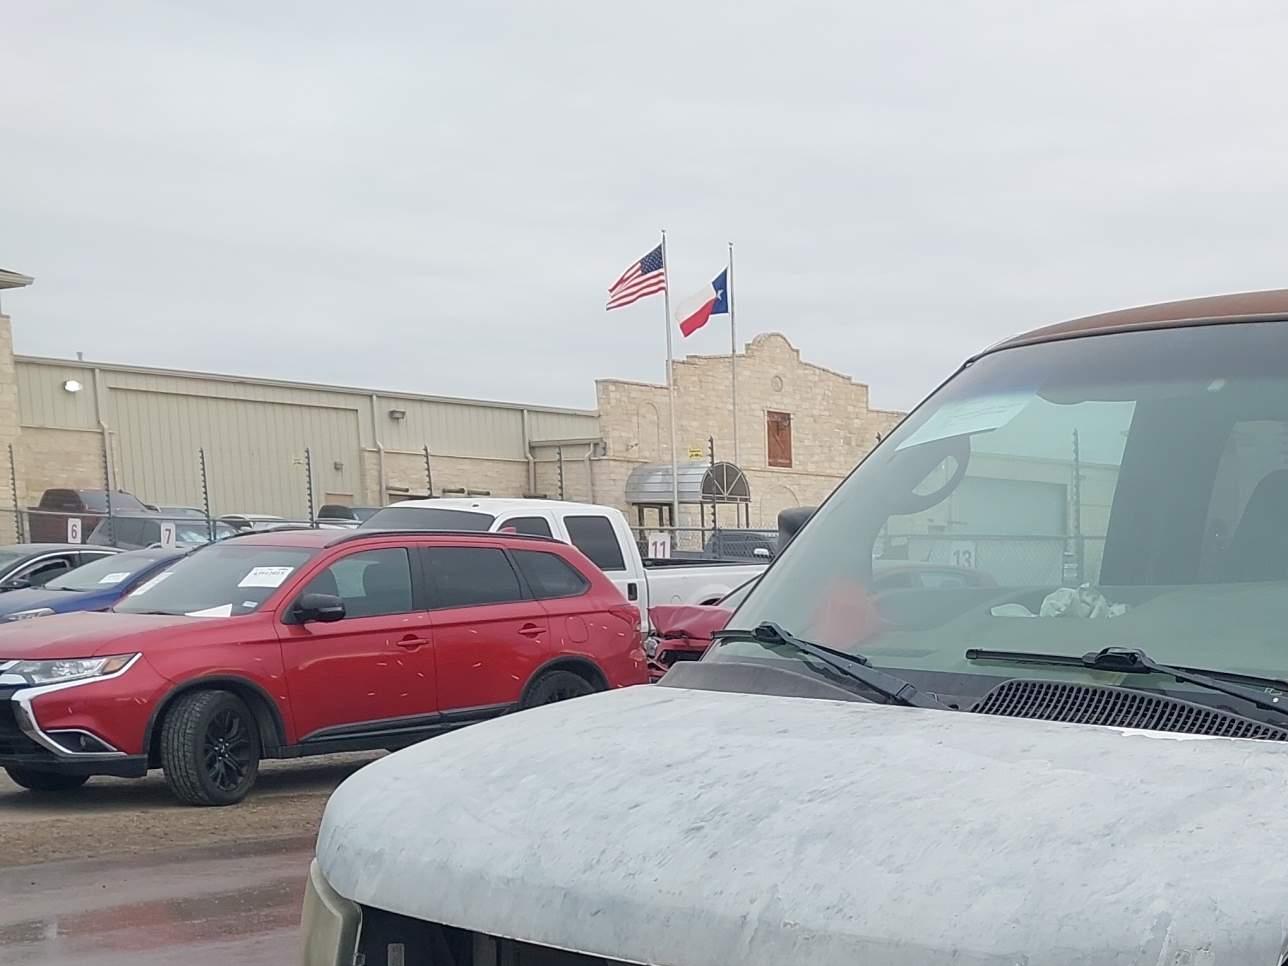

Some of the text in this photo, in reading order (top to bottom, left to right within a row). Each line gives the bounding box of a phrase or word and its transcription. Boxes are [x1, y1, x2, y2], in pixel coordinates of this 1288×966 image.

[71, 523, 78, 540] 6
[164, 528, 172, 545] 7
[651, 540, 666, 559] 11
